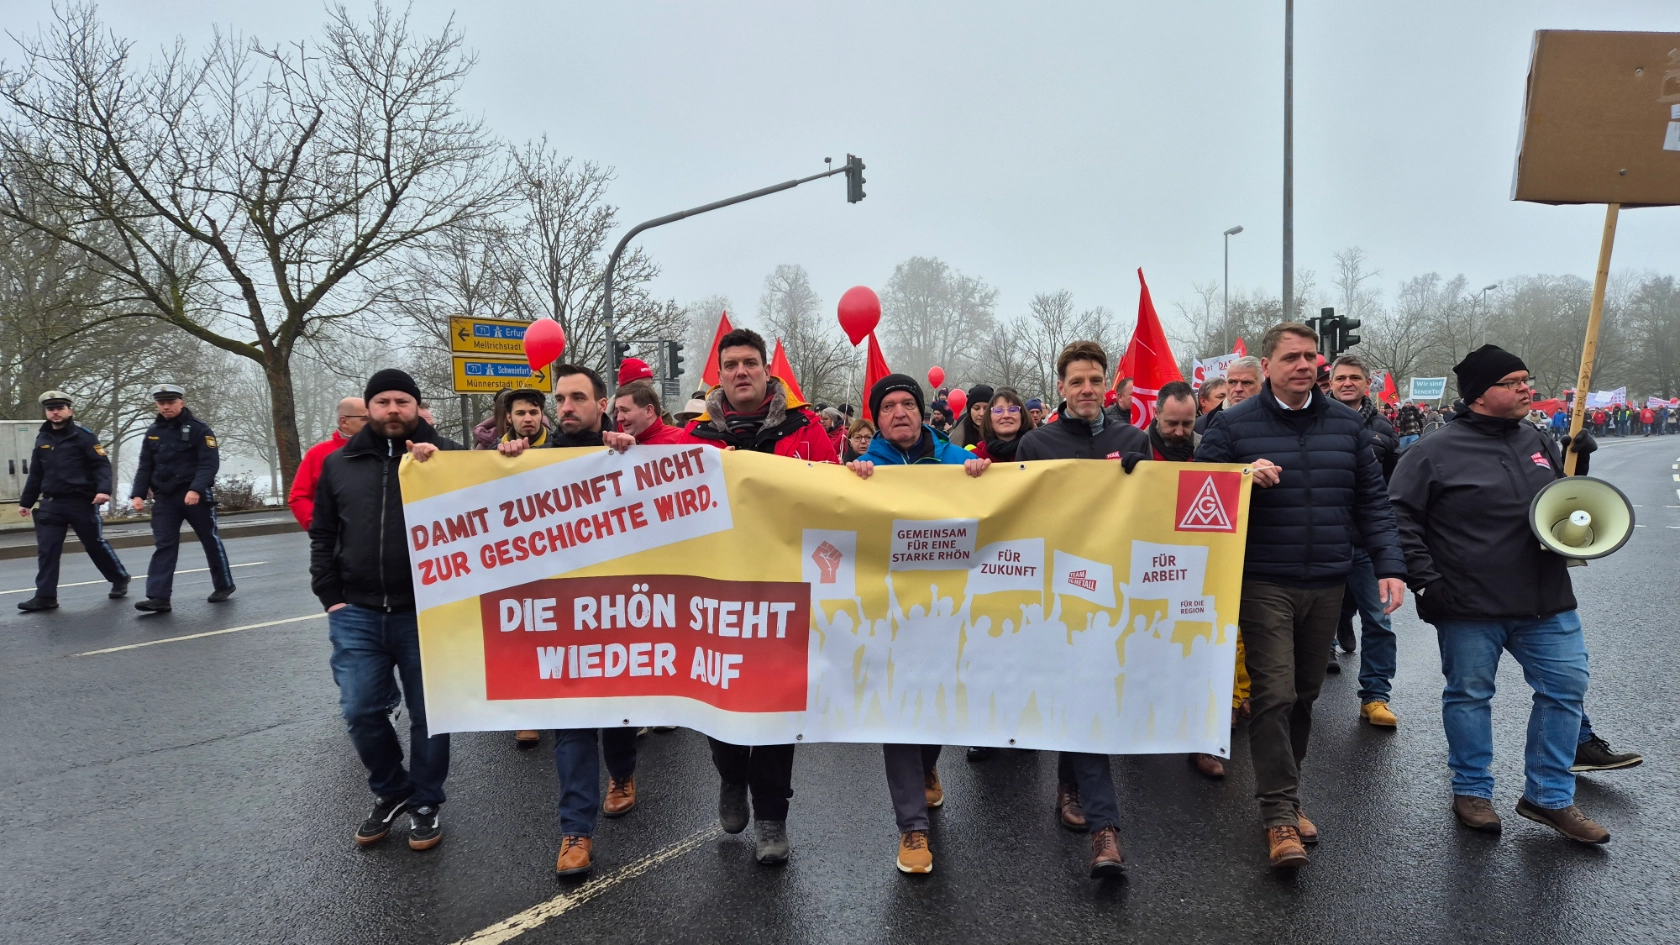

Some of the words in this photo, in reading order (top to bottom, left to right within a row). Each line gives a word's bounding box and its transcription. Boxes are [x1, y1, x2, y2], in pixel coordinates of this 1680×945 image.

[474, 341, 521, 350] Mellrichstadt
[497, 366, 530, 375] Schweinfurt
[466, 379, 514, 388] Münnerstadt
[516, 380, 523, 388] 10
[411, 506, 491, 552] DAMIT
[499, 469, 624, 527] ZUKUNFT
[633, 447, 706, 491] NICHT
[417, 550, 472, 586] ZUR
[479, 502, 648, 570] GESCHICHTE
[657, 484, 718, 522] WIRD.
[897, 528, 967, 540] GEMEINSAM
[907, 539, 929, 551] FÜR
[931, 539, 957, 549] EINE
[892, 551, 935, 563] STARKE
[938, 549, 970, 560] RHÖN
[997, 549, 1021, 563] FÜR
[1152, 553, 1176, 568] FÜR
[980, 563, 1037, 577] ZUKUNFT
[1142, 568, 1188, 583] ARBEIT
[499, 597, 557, 632] DIE
[573, 583, 677, 632] RHÖN
[689, 595, 796, 639] STEHT
[1180, 600, 1193, 608] FÜR
[1180, 607, 1205, 615] REGION
[537, 641, 677, 680] WIEDER
[690, 646, 744, 690] AUF
